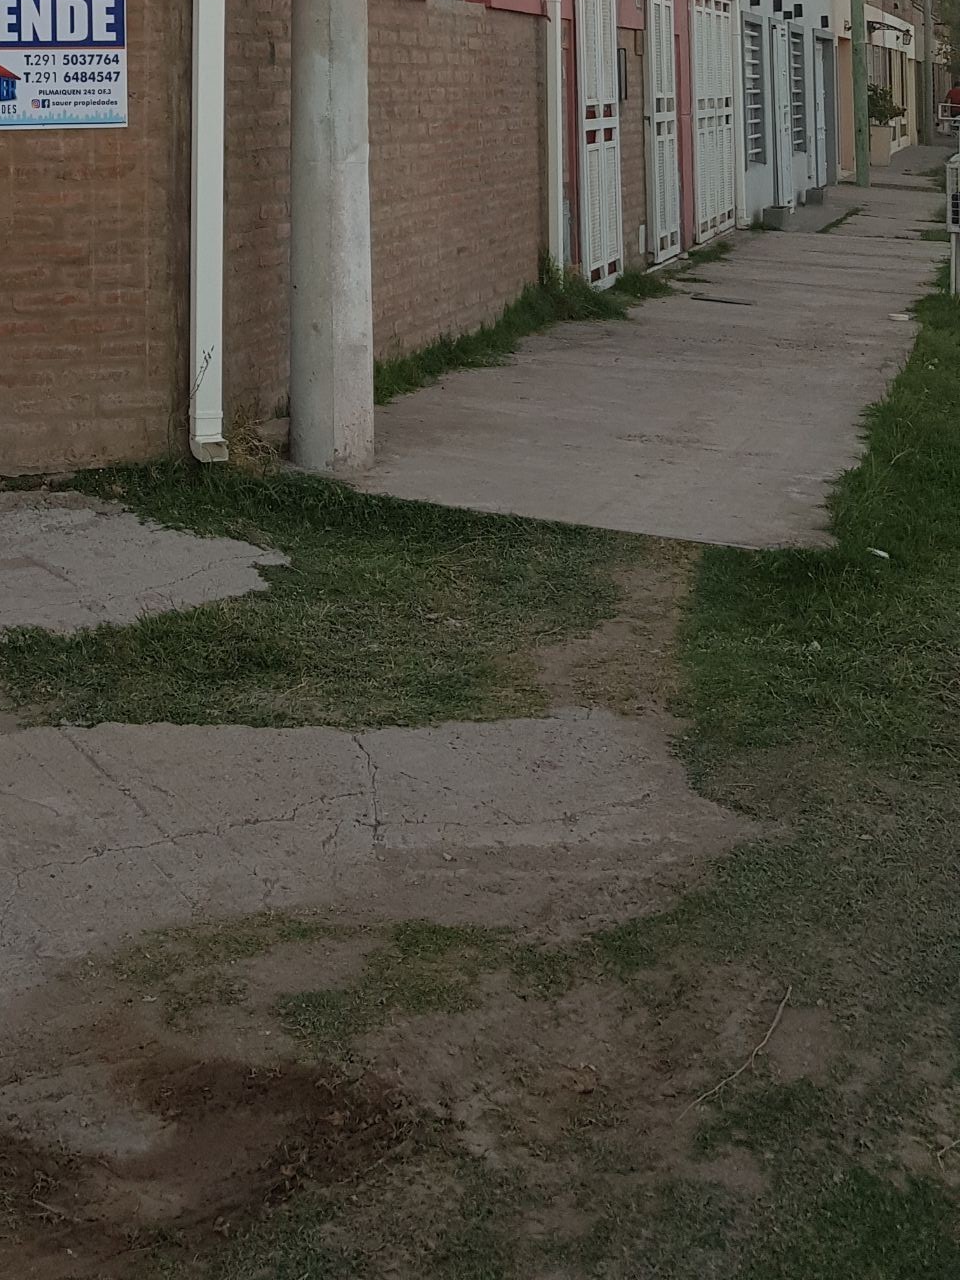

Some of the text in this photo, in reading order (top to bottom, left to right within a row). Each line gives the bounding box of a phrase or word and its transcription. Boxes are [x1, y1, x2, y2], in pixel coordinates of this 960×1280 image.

[23, 54, 120, 66] T.291 5037764
[23, 71, 121, 83] T.291 6484547
[73, 99, 118, 108] propiedades
